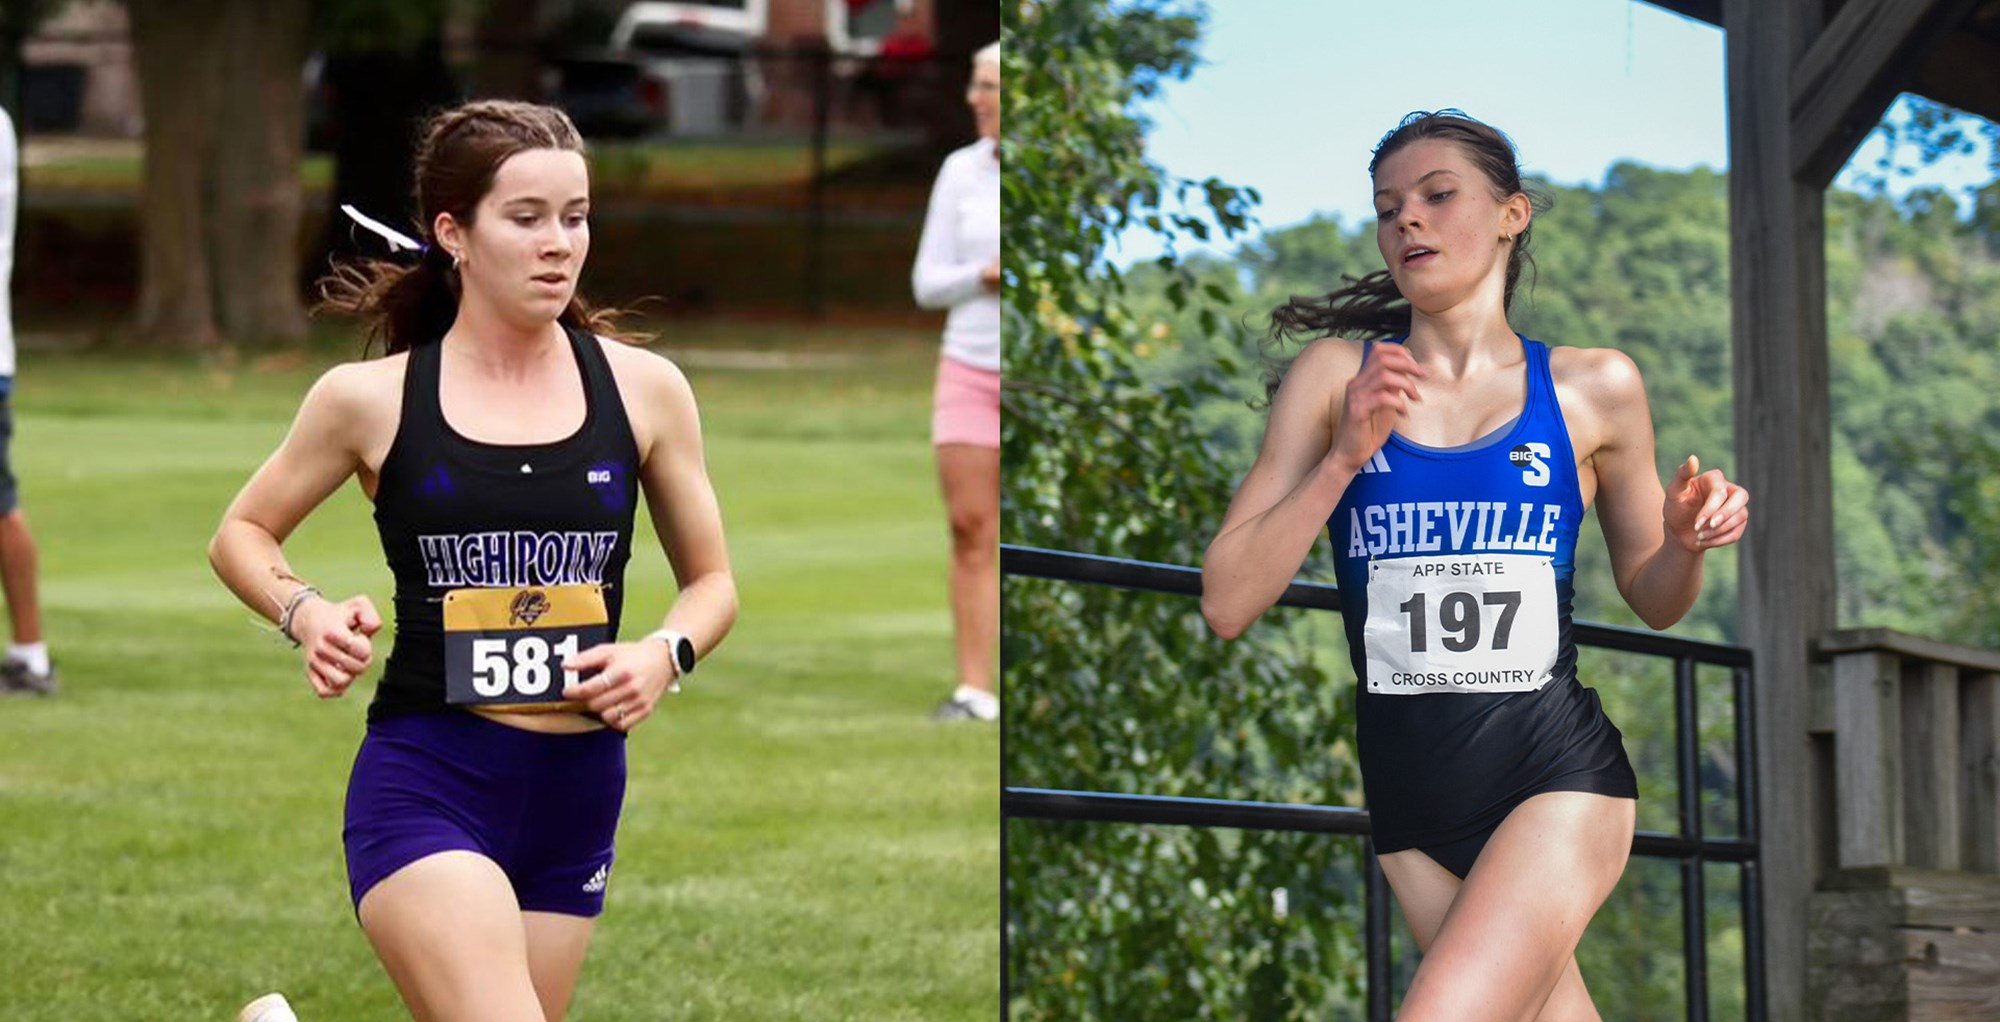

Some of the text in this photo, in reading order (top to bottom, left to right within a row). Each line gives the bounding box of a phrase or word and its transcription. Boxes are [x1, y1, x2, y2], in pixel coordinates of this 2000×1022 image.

[587, 470, 611, 483] BIG
[1509, 451, 1533, 461] BIG
[1522, 442, 1551, 487] S
[1348, 501, 1561, 557] ASHEVILLE
[418, 531, 618, 586] HIGH POINT
[1412, 562, 1505, 577] APP STATE
[1400, 591, 1522, 653] 197
[472, 634, 579, 697] 581
[1391, 669, 1535, 686] CROSS COUNTRY
